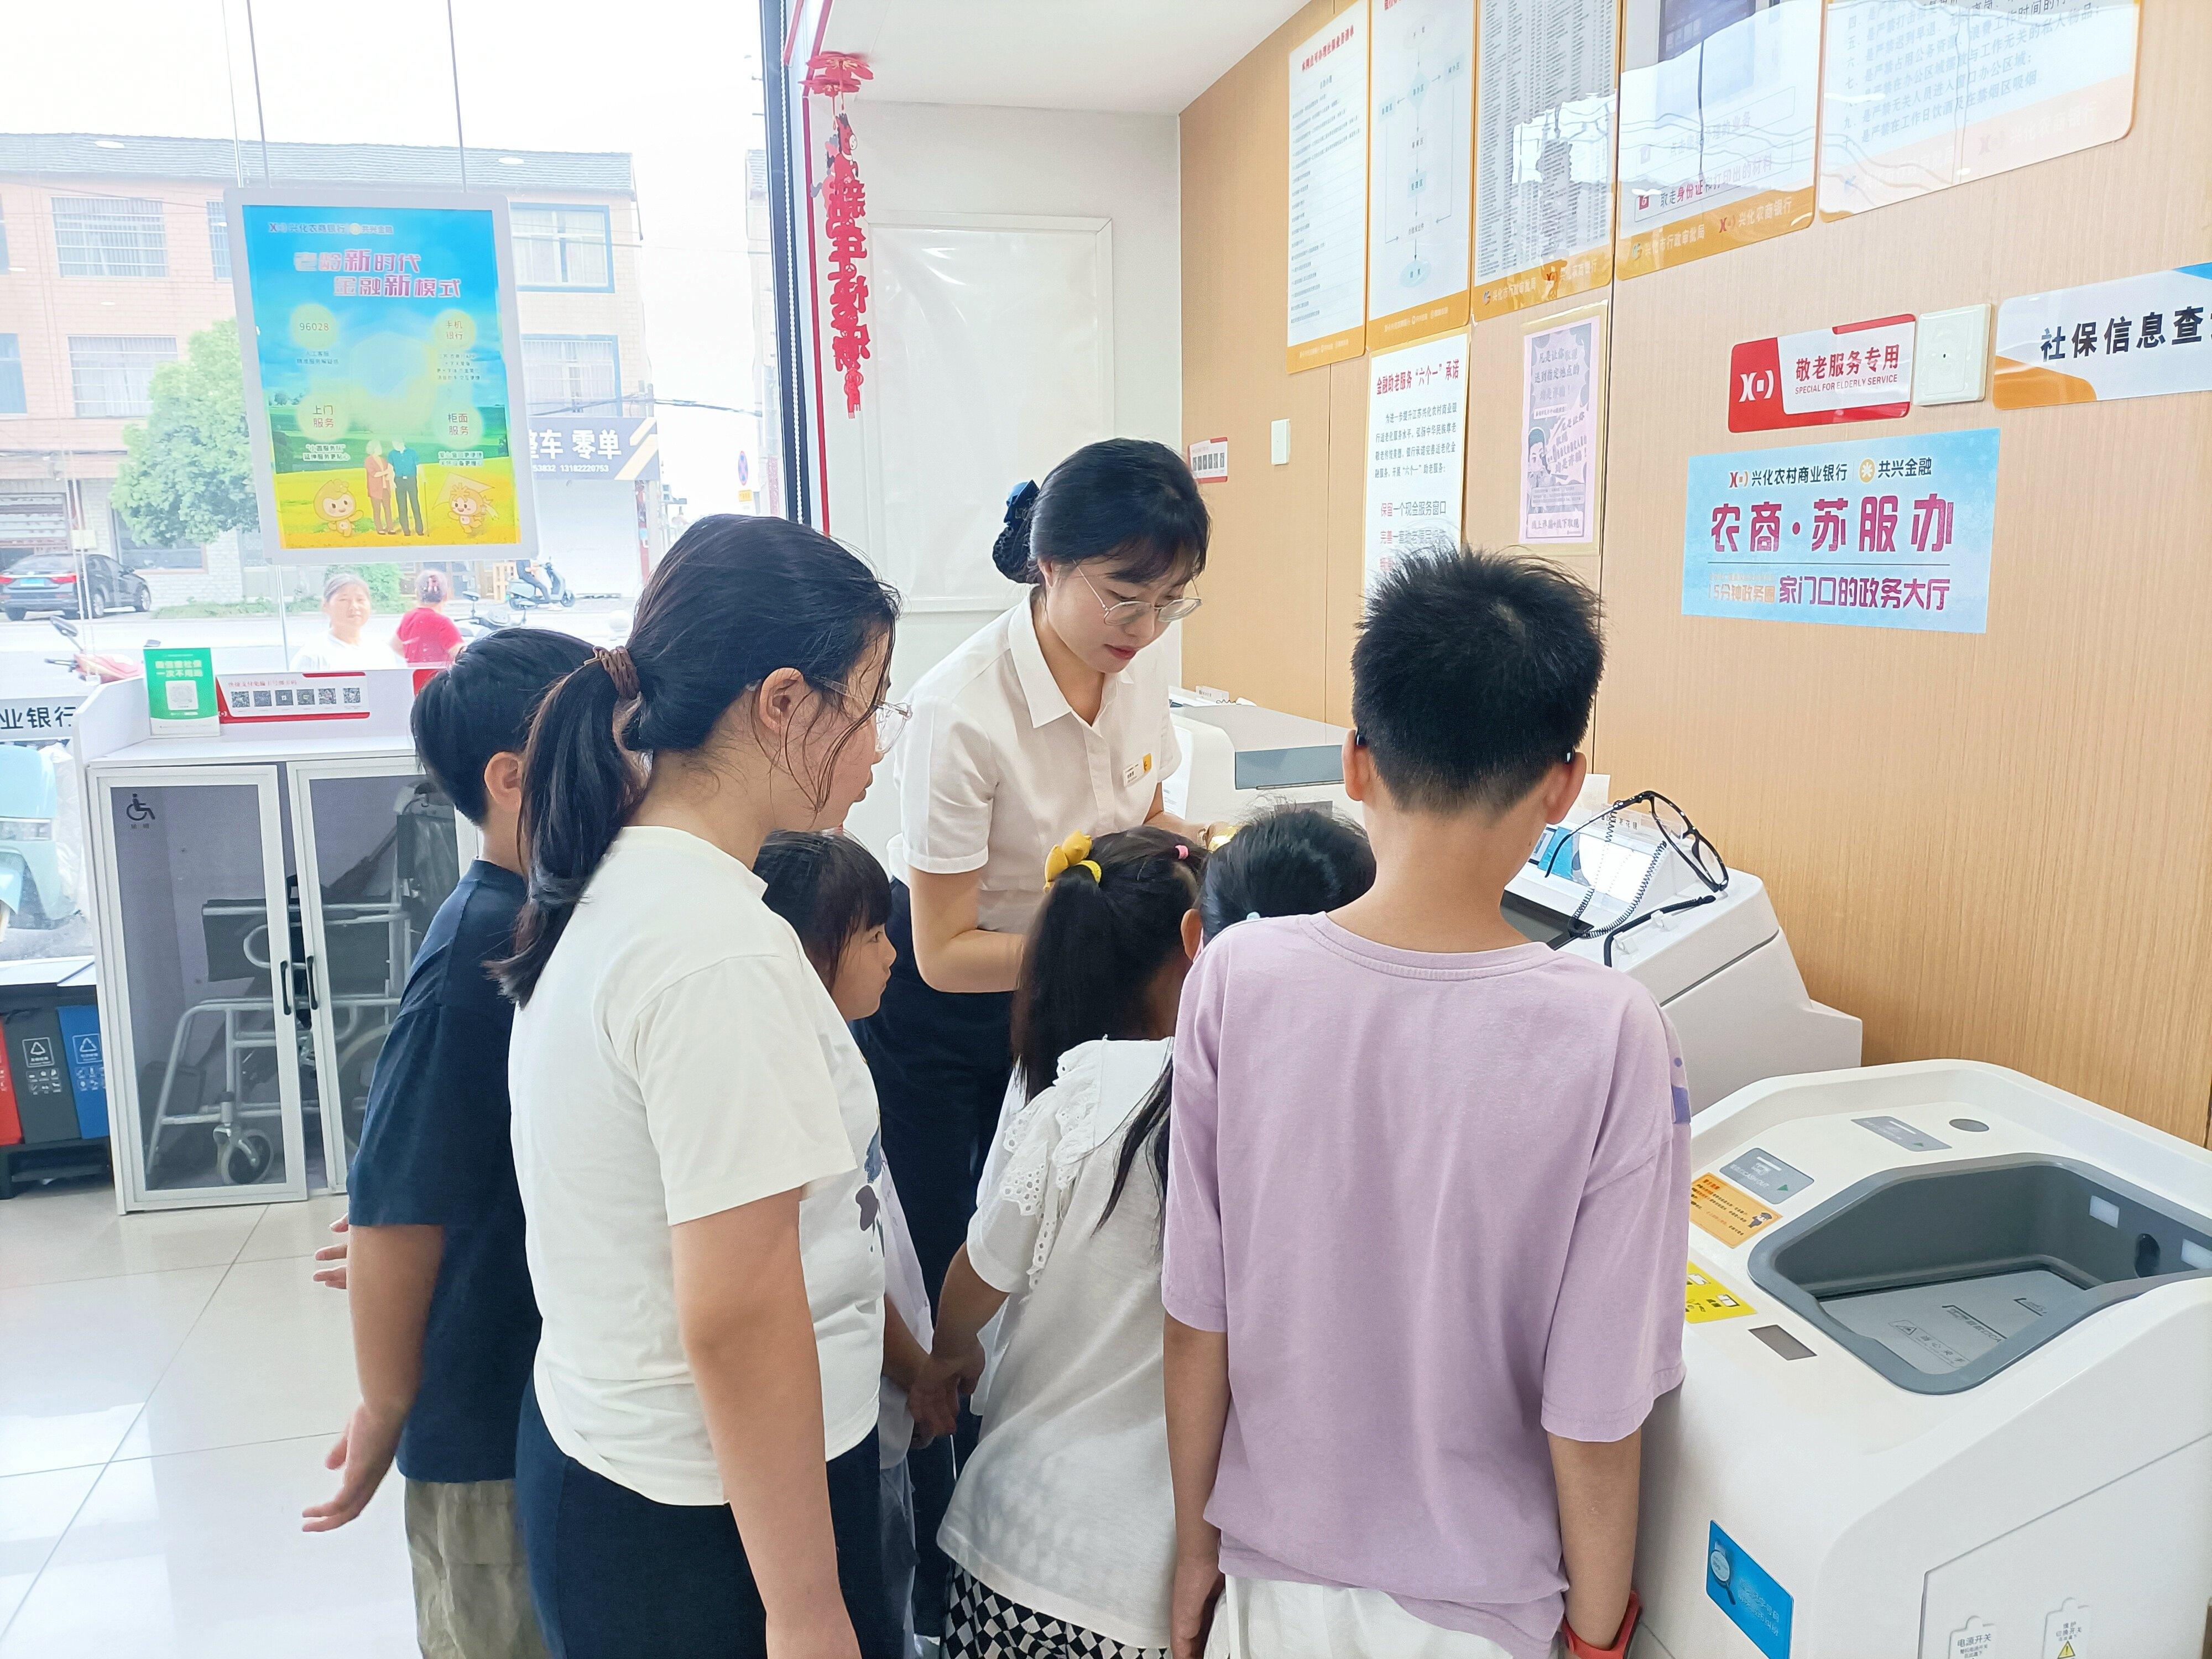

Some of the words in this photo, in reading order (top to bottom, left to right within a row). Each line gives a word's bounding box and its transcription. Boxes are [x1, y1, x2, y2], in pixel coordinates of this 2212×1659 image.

[294, 249, 421, 273] 老龄新时代
[333, 274, 461, 298] 金融新模式
[299, 322, 329, 331] 96028
[2039, 306, 2212, 363] 社保信息查
[1796, 344, 1900, 382] 敬老服务专用
[1795, 385, 1821, 395] SPECIAL
[1822, 382, 1835, 391] FOR
[1836, 378, 1866, 389] ELDERLY
[1867, 374, 1898, 385] SERVICE
[312, 404, 333, 415] 上门
[448, 413, 468, 424] 柜面
[313, 418, 334, 429] 服务
[449, 426, 469, 436] 服务
[572, 429, 622, 461] 零单
[1750, 463, 1848, 487] 兴化农村商业银行
[1878, 457, 1933, 478] 共兴金融
[1380, 500, 1447, 517] 保留一个现金服务窗口
[1710, 493, 1954, 553] 农商·苏服办
[1778, 575, 1951, 611] 家门口的政务大厅
[0, 706, 76, 729] 业银行
[1957, 1634, 1991, 1647] 电源开关
